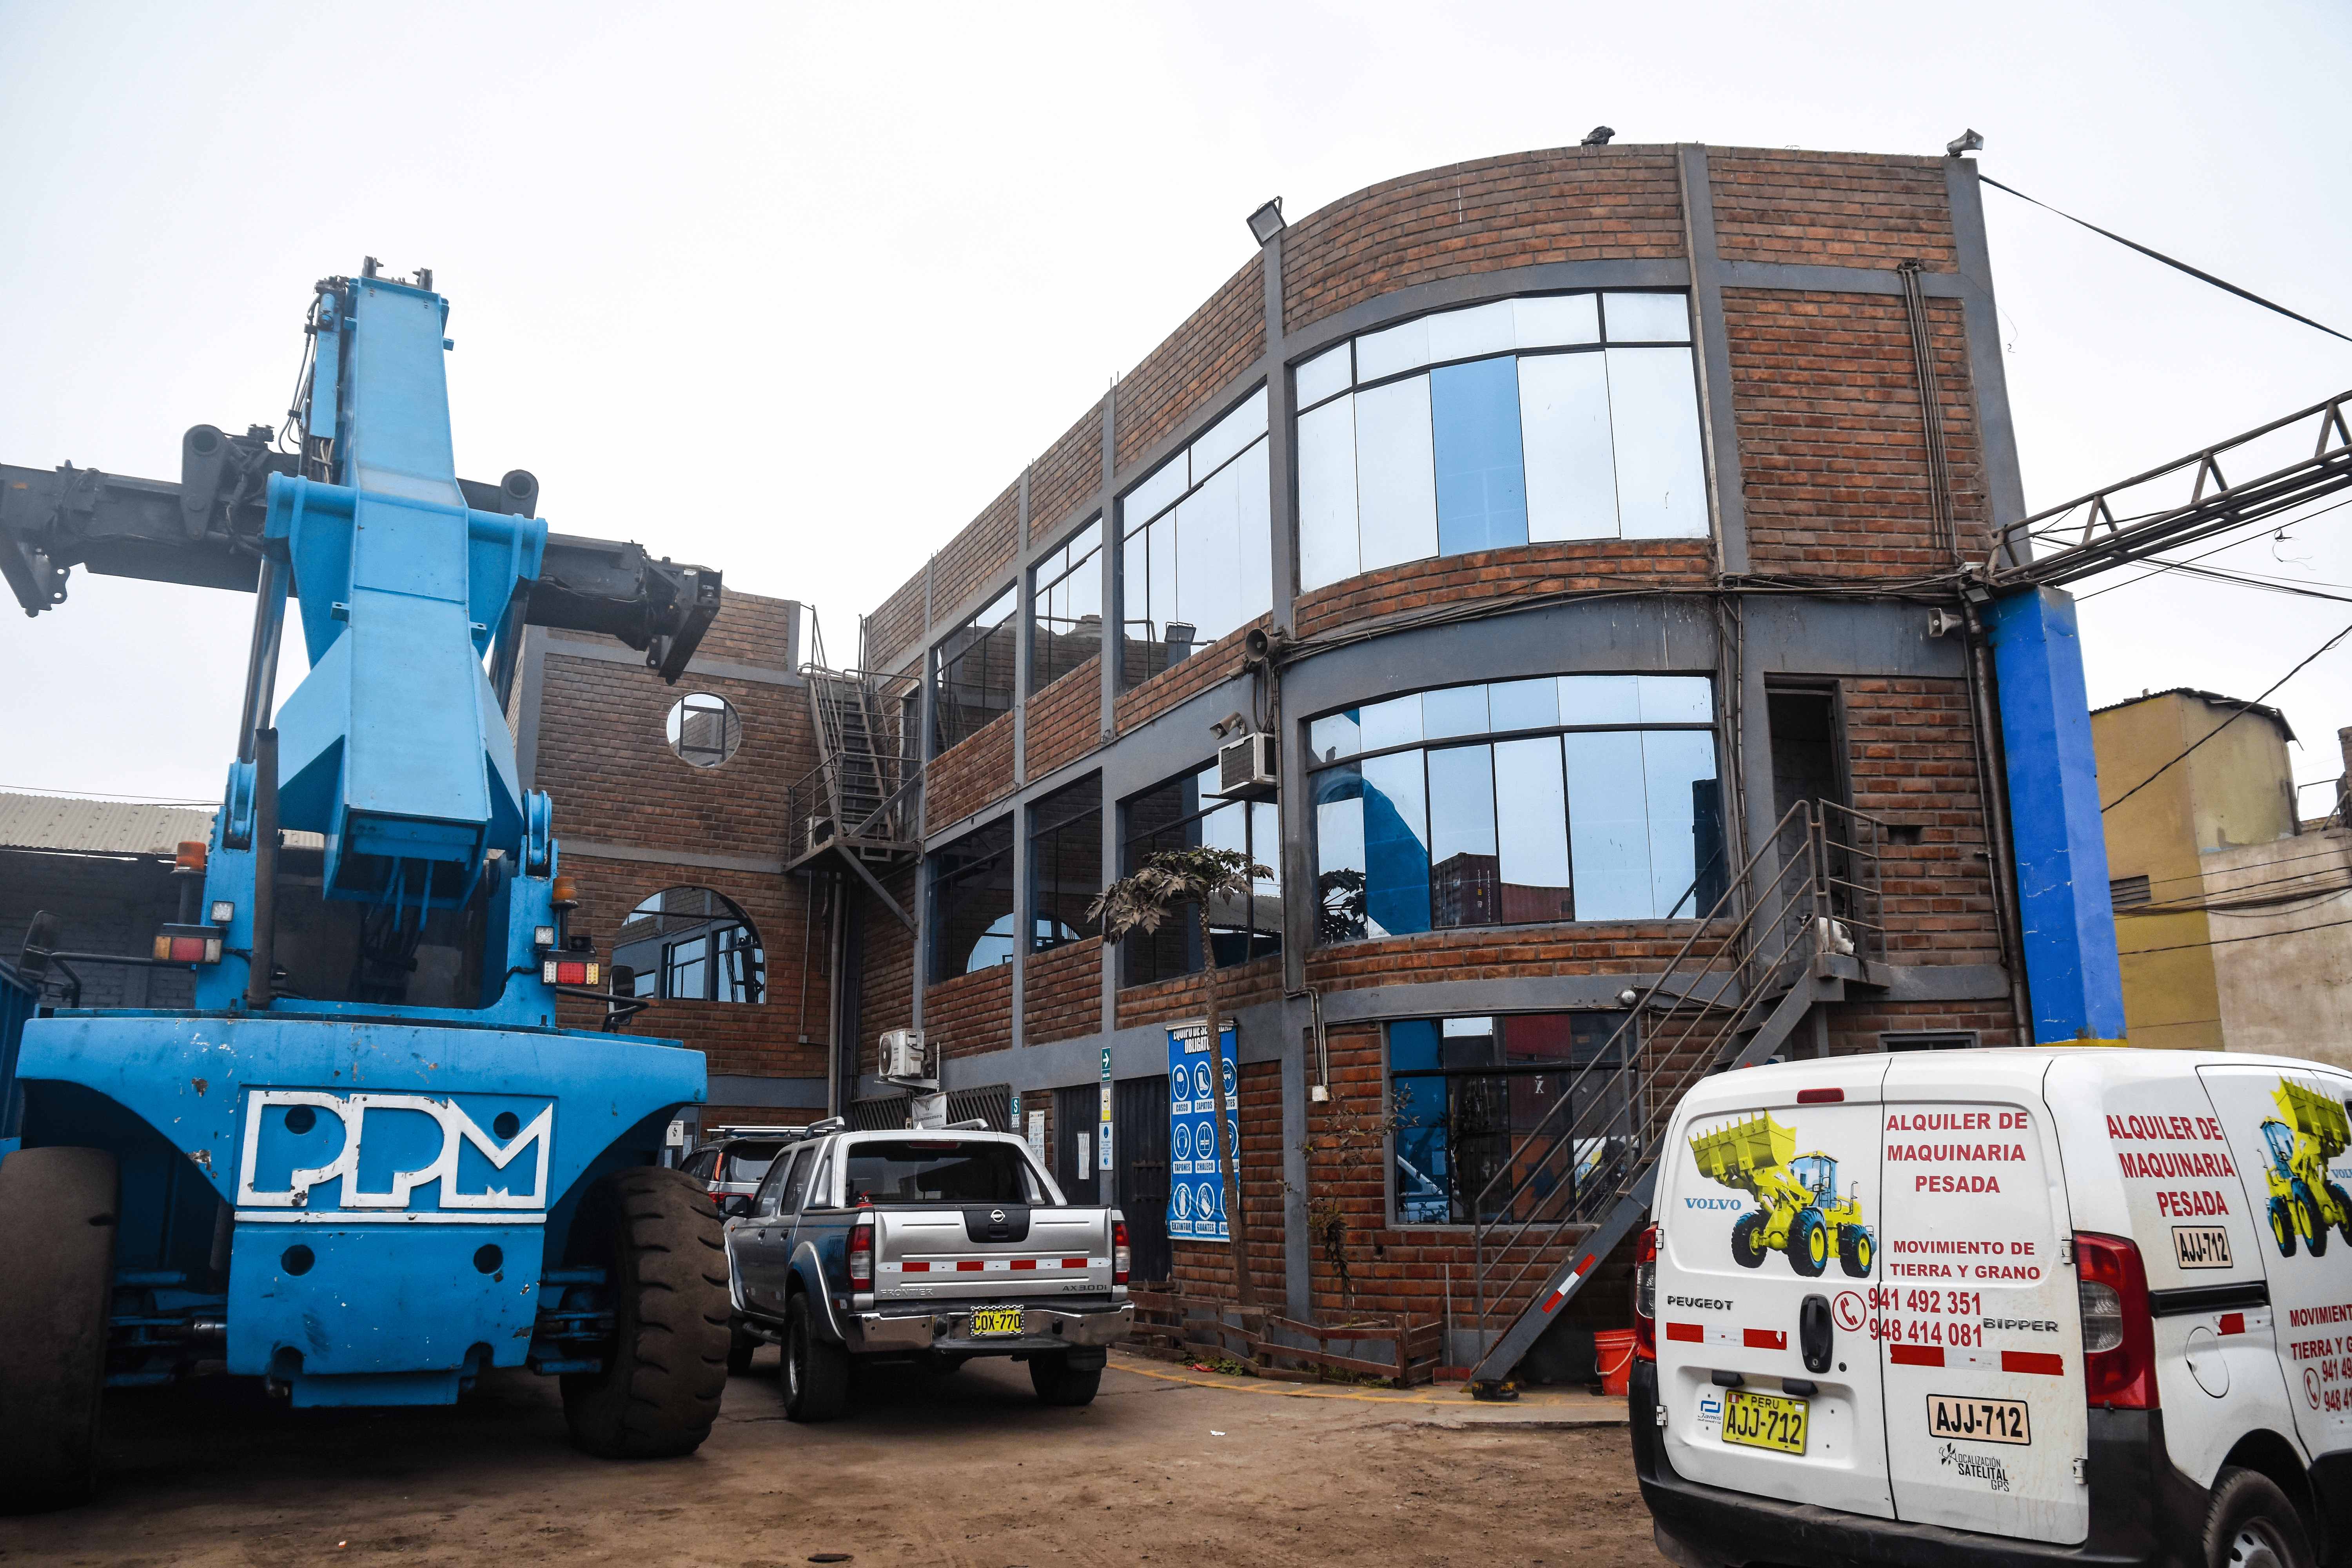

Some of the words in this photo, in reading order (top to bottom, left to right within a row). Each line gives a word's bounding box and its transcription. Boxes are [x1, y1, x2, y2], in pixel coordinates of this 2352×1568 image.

[1185, 1036, 1210, 1054] OBLIGATO
[1014, 1099, 1018, 1113] S
[1176, 1103, 1188, 1112] CASCO
[1196, 1101, 1212, 1111] ZAPATOS
[1886, 1113, 1991, 1132] ALQUILER
[1999, 1112, 2028, 1129] DE
[2106, 1114, 2198, 1141] ALQUILER
[2196, 1117, 2224, 1140] DE
[236, 1091, 553, 1209] PPM
[1887, 1144, 2026, 1163] MAQUINARIA
[1174, 1163, 1191, 1171] TAPONES
[1197, 1162, 1213, 1171] CHALECO
[2118, 1153, 2236, 1179] MAQUINARIA
[1916, 1176, 2000, 1193] PESADA
[1684, 1198, 1741, 1210] VOLVO
[2156, 1191, 2230, 1217] PESADA
[1172, 1222, 1191, 1231] EXTINTOR
[1197, 1223, 1214, 1232] GUANTES
[1893, 1241, 2004, 1255] MOVIMIENTO
[2011, 1242, 2035, 1255] DE
[2180, 1232, 2229, 1262] AJJ-712
[1890, 1263, 1952, 1278] TIERRA
[1957, 1265, 1969, 1278] Y
[1975, 1265, 2041, 1280] GRANO
[880, 1289, 933, 1297] FRONTIER
[1667, 1295, 1733, 1310] PEUGEOT
[1868, 1288, 1899, 1311] 941
[1907, 1289, 1941, 1313] 492
[1947, 1291, 1981, 1316] 351
[1869, 1318, 1902, 1342] 948
[1908, 1320, 1942, 1345] 414
[1948, 1323, 1982, 1348] 081
[1983, 1318, 2059, 1332] BIPPER
[2291, 1338, 2333, 1360] TIERRA
[2335, 1337, 2343, 1354] Y
[2322, 1358, 2338, 1383] 941
[1751, 1396, 1780, 1409] PERU
[2325, 1389, 2341, 1412] 948
[1726, 1405, 1802, 1445] AJJ-712
[1936, 1402, 2023, 1438] AJJ-712
[1955, 1453, 2001, 1468] LOCALIZACIÓN
[1958, 1463, 2008, 1481] SATELITAL
[1991, 1480, 2009, 1492] GPS
